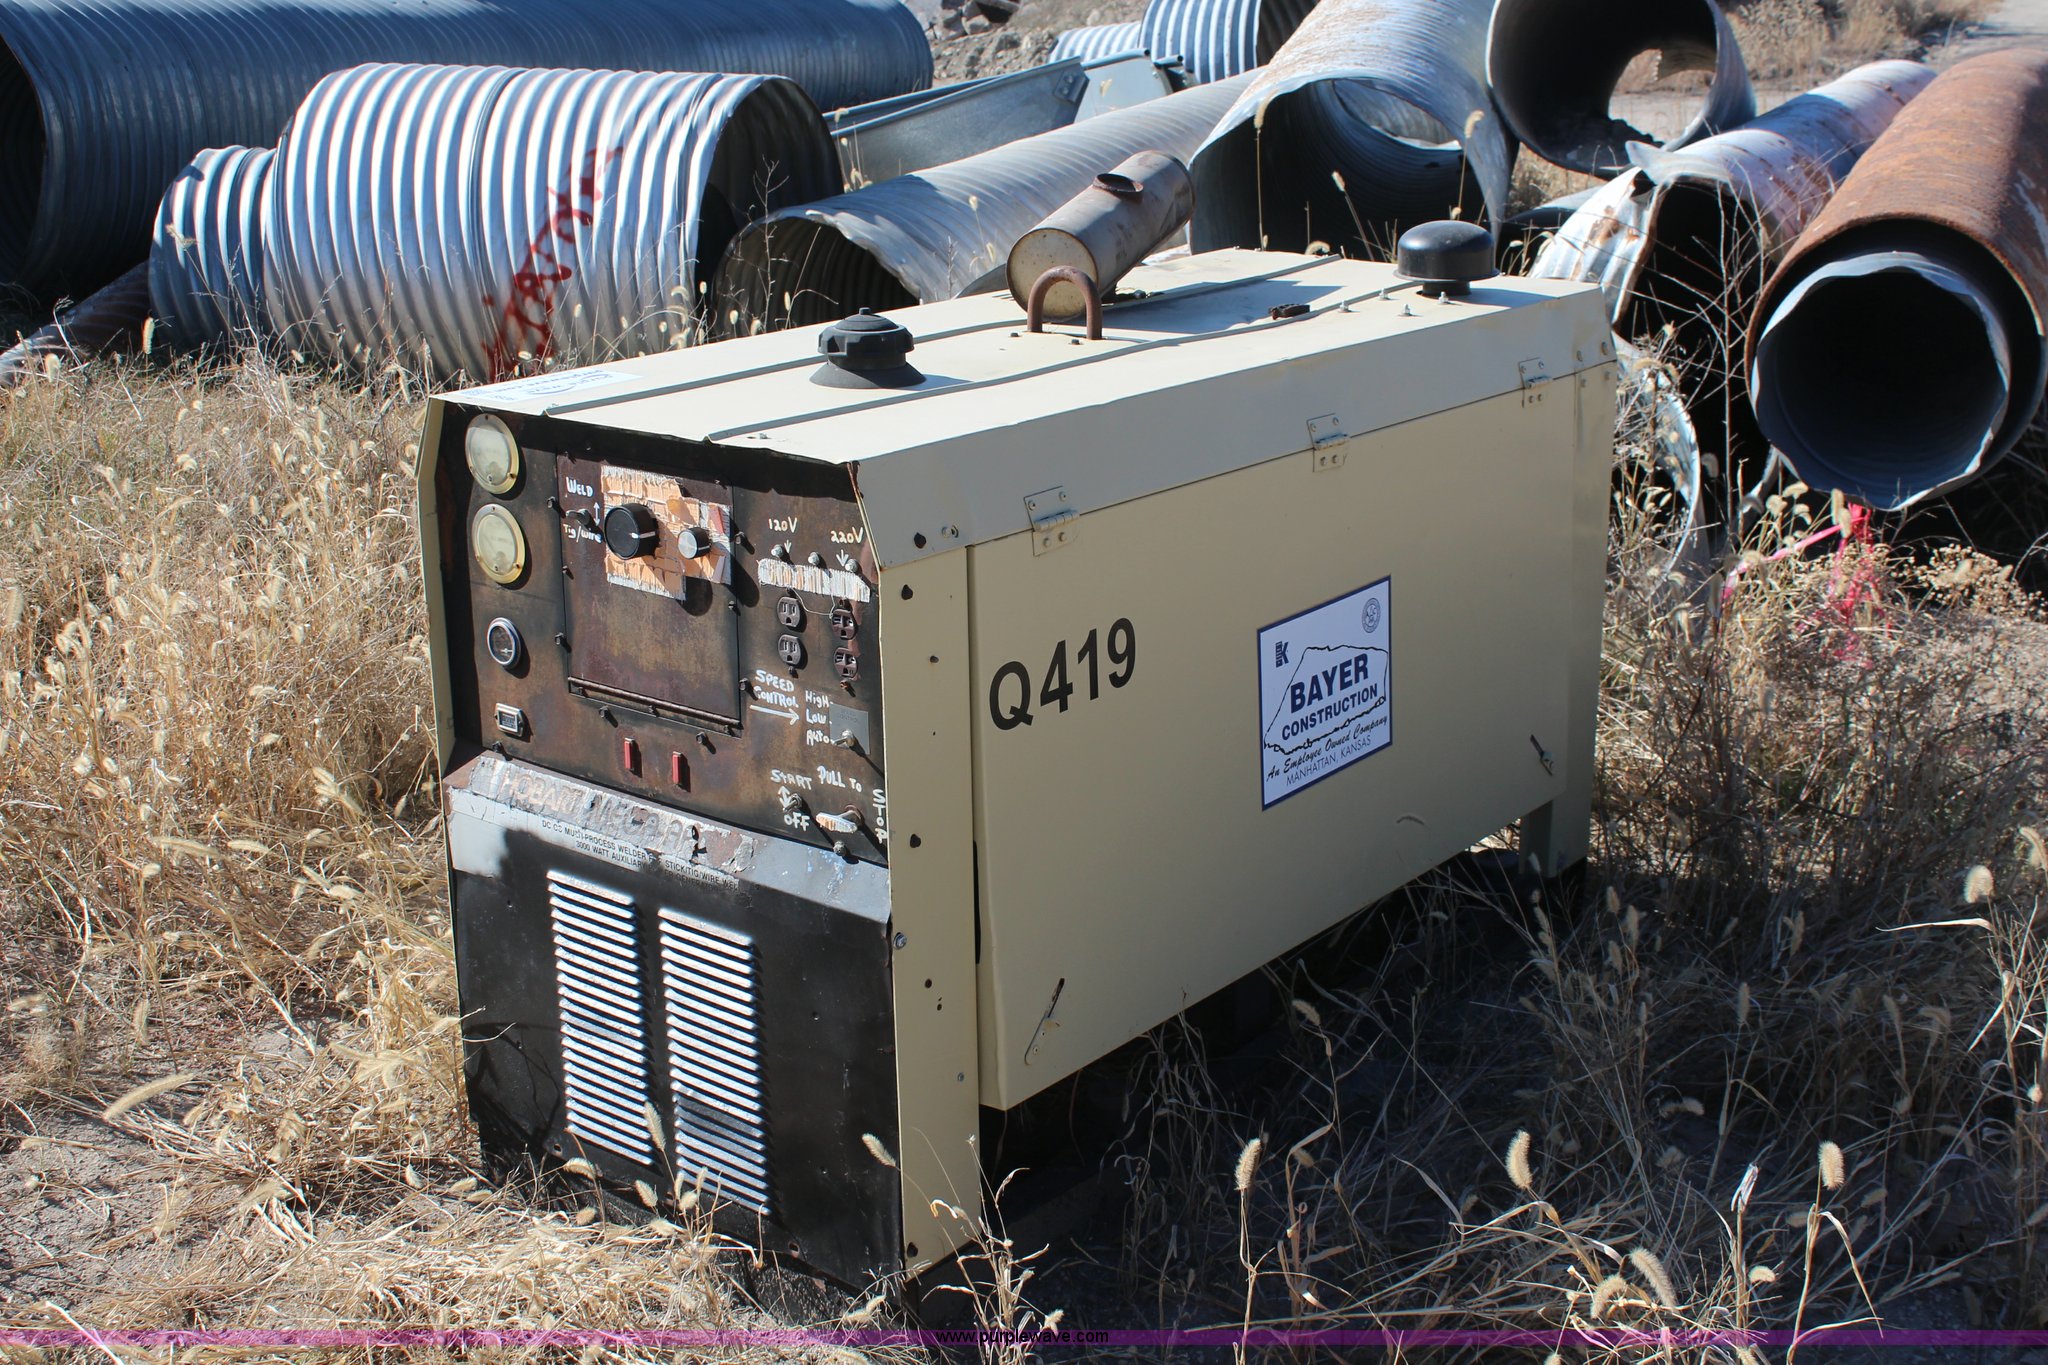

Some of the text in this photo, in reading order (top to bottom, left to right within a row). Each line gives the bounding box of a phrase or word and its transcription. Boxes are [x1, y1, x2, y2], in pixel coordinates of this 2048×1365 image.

[768, 516, 798, 533] 120V
[830, 526, 863, 544] 220V
[755, 669, 795, 693] SPEED
[989, 617, 1136, 730] Q419
[1290, 653, 1369, 714] BAYER
[753, 685, 799, 708] CONTROL
[1281, 683, 1378, 741] CONSTRUCTION
[1266, 715, 1388, 782] An Employee Owned Company
[1286, 734, 1371, 787] MANHATTAN, KANSAS
[770, 769, 813, 791] START
[816, 765, 846, 788] PULL
[872, 788, 888, 844] STOP
[576, 840, 591, 852] 3000
[591, 845, 610, 859] WATT
[617, 844, 646, 860] WELDER
